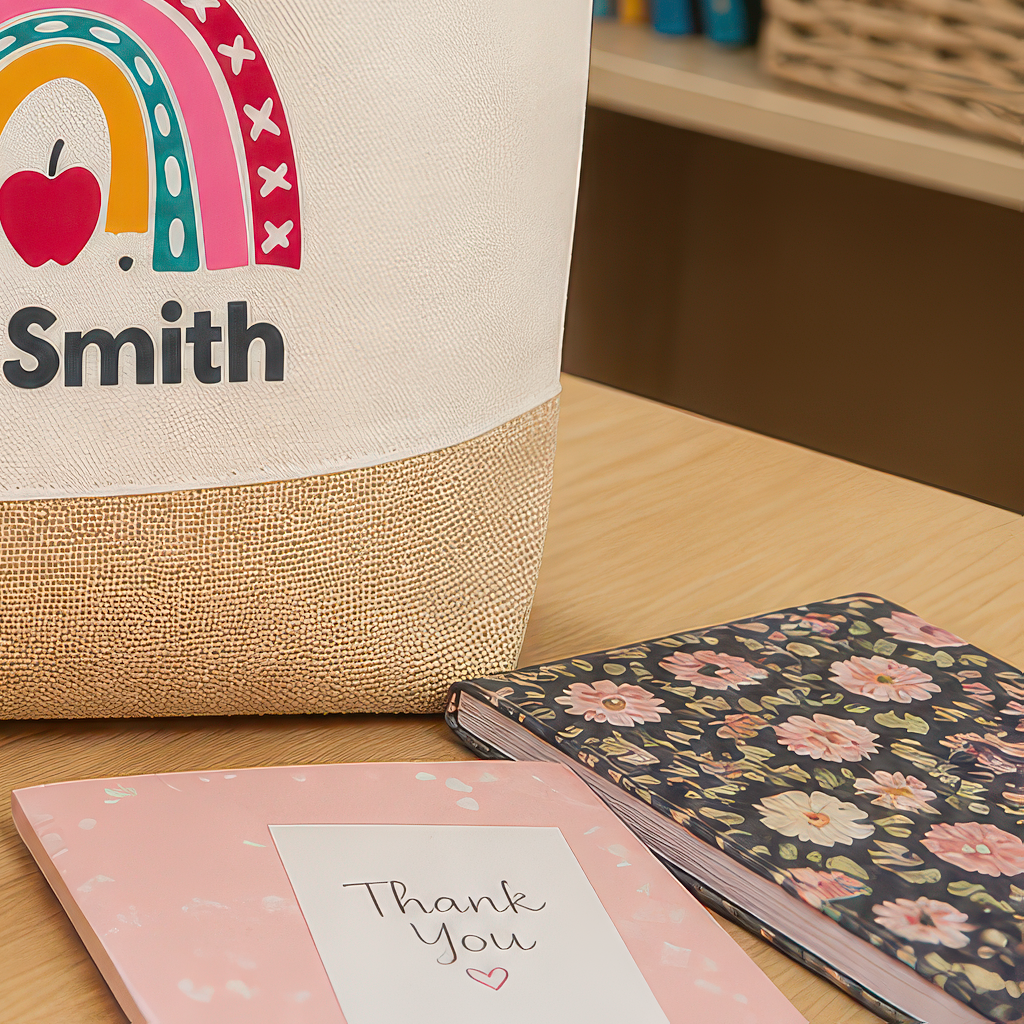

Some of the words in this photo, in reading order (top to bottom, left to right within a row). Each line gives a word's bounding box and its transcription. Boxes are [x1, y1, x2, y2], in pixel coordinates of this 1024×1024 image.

[2, 300, 285, 389] Smith
[342, 879, 547, 918] Thank
[409, 922, 537, 965] You
